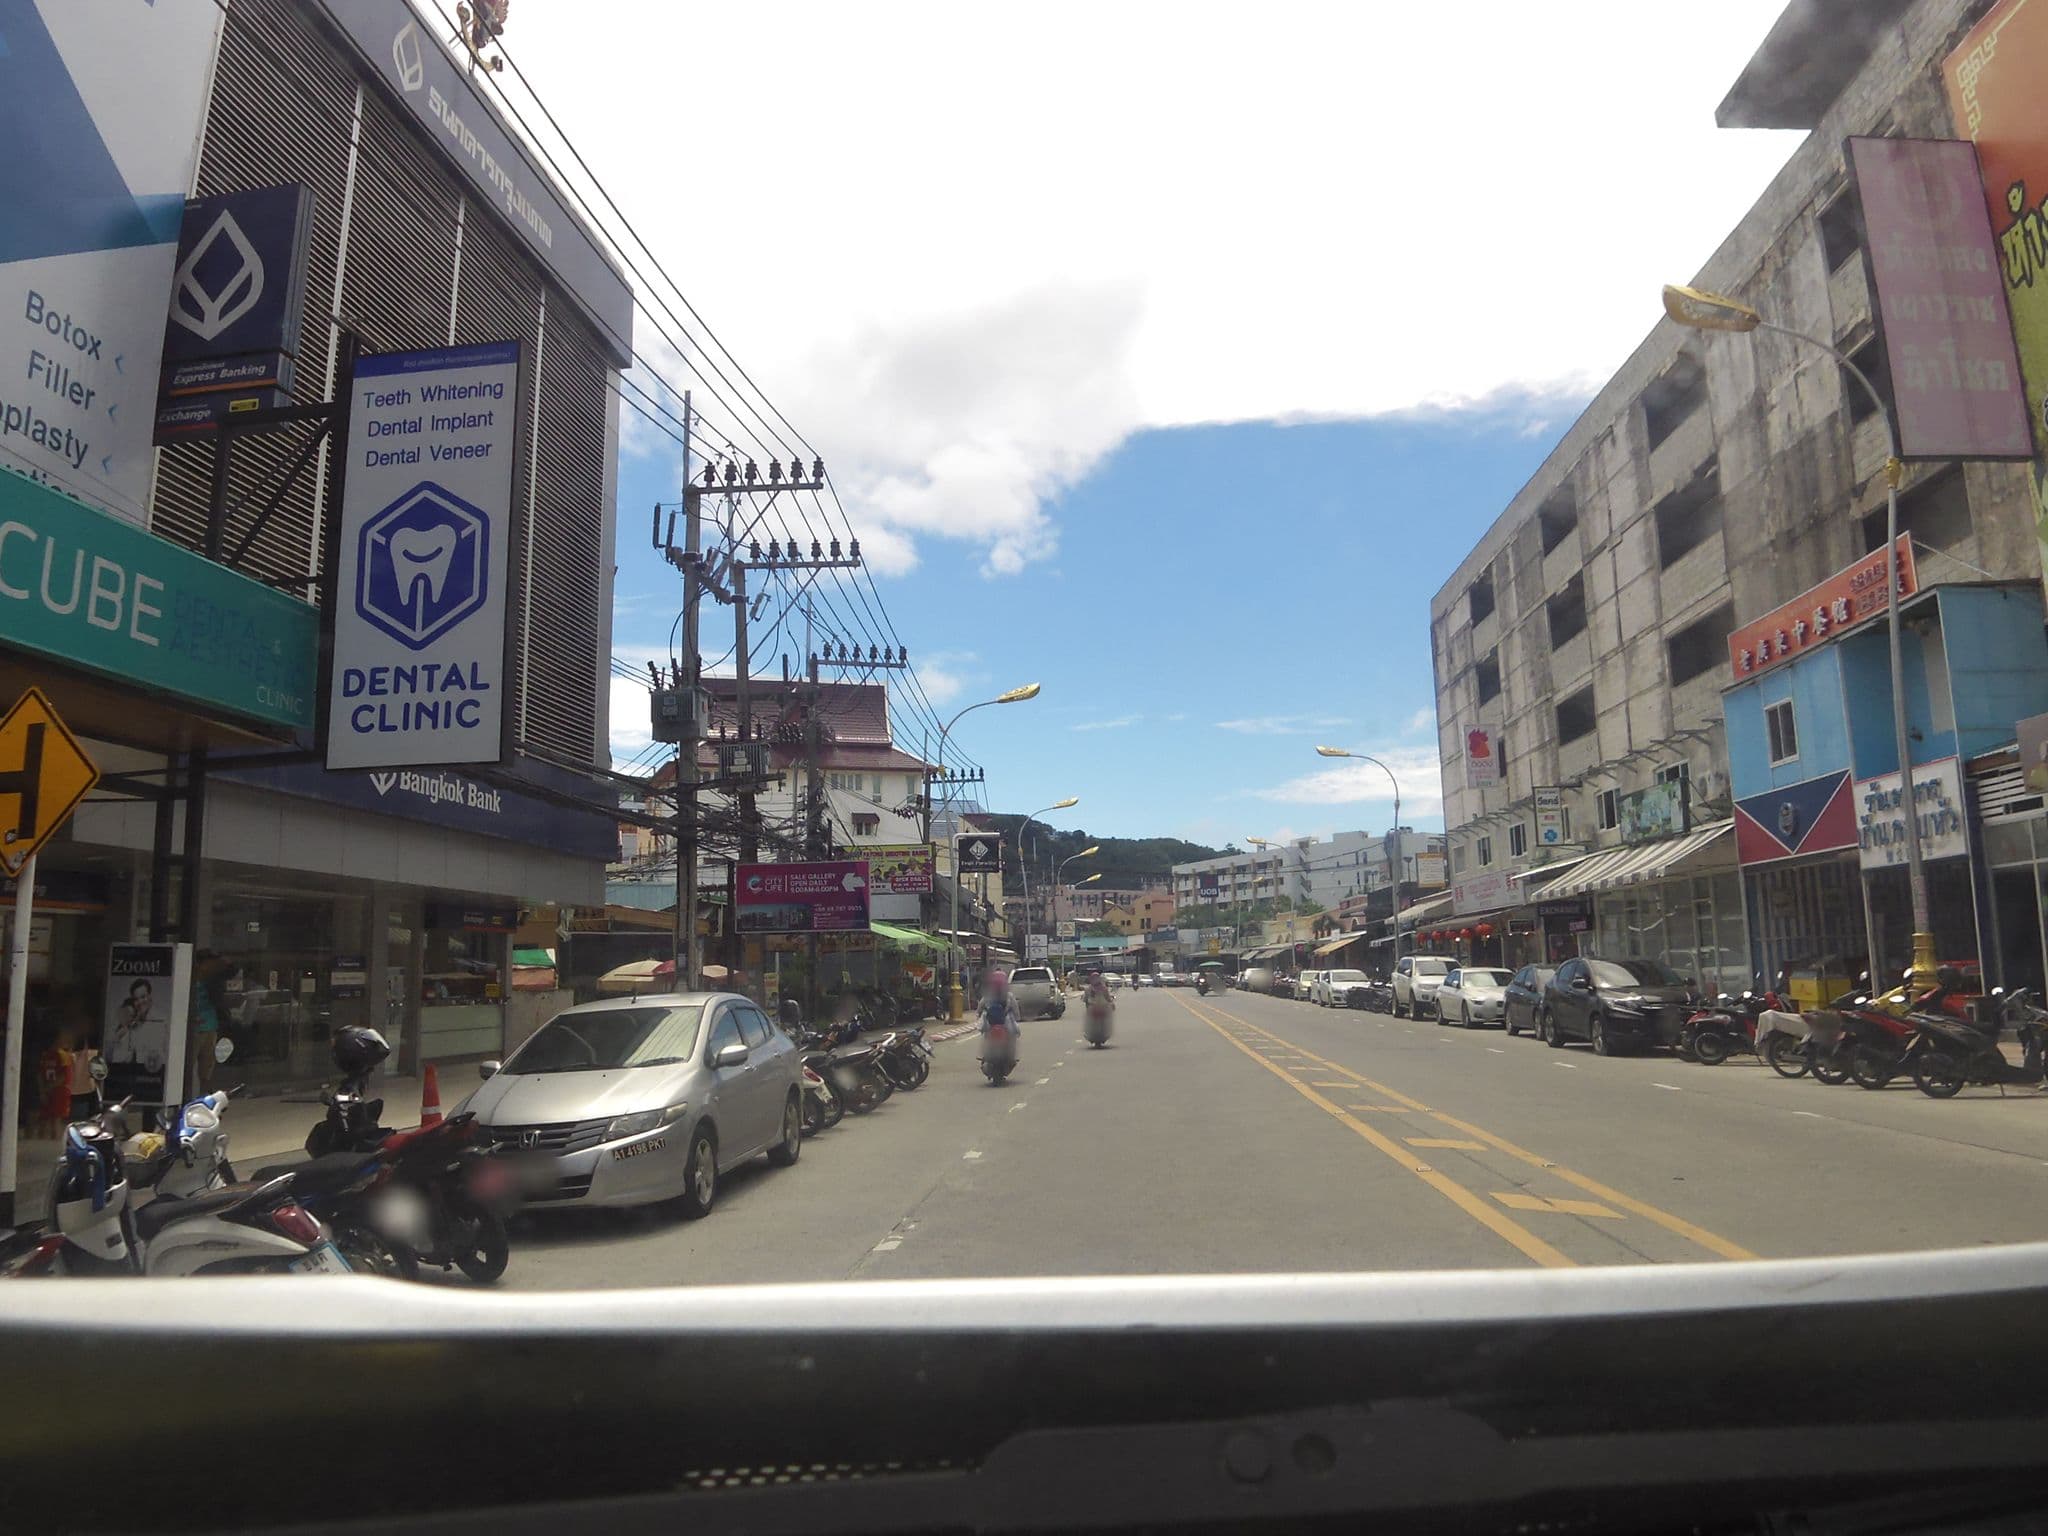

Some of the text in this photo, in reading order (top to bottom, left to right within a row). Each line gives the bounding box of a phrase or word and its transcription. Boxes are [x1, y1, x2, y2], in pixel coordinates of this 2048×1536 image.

[26, 290, 102, 361] Botox
[27, 349, 96, 411] Filler
[173, 371, 216, 385] Express
[219, 364, 267, 379] Banking
[363, 381, 504, 409] Teeth Whitening
[160, 409, 212, 422] Exchange
[368, 410, 494, 438] Dental Implant
[0, 401, 89, 469] plasty
[366, 443, 493, 467] Dental Veneer
[0, 520, 165, 647] CUBE
[343, 661, 490, 698] DENTAL
[257, 685, 304, 714] CLINIC
[351, 699, 481, 734] CLINIC
[399, 771, 501, 814] Bangkok Bank
[765, 876, 783, 885] CITY
